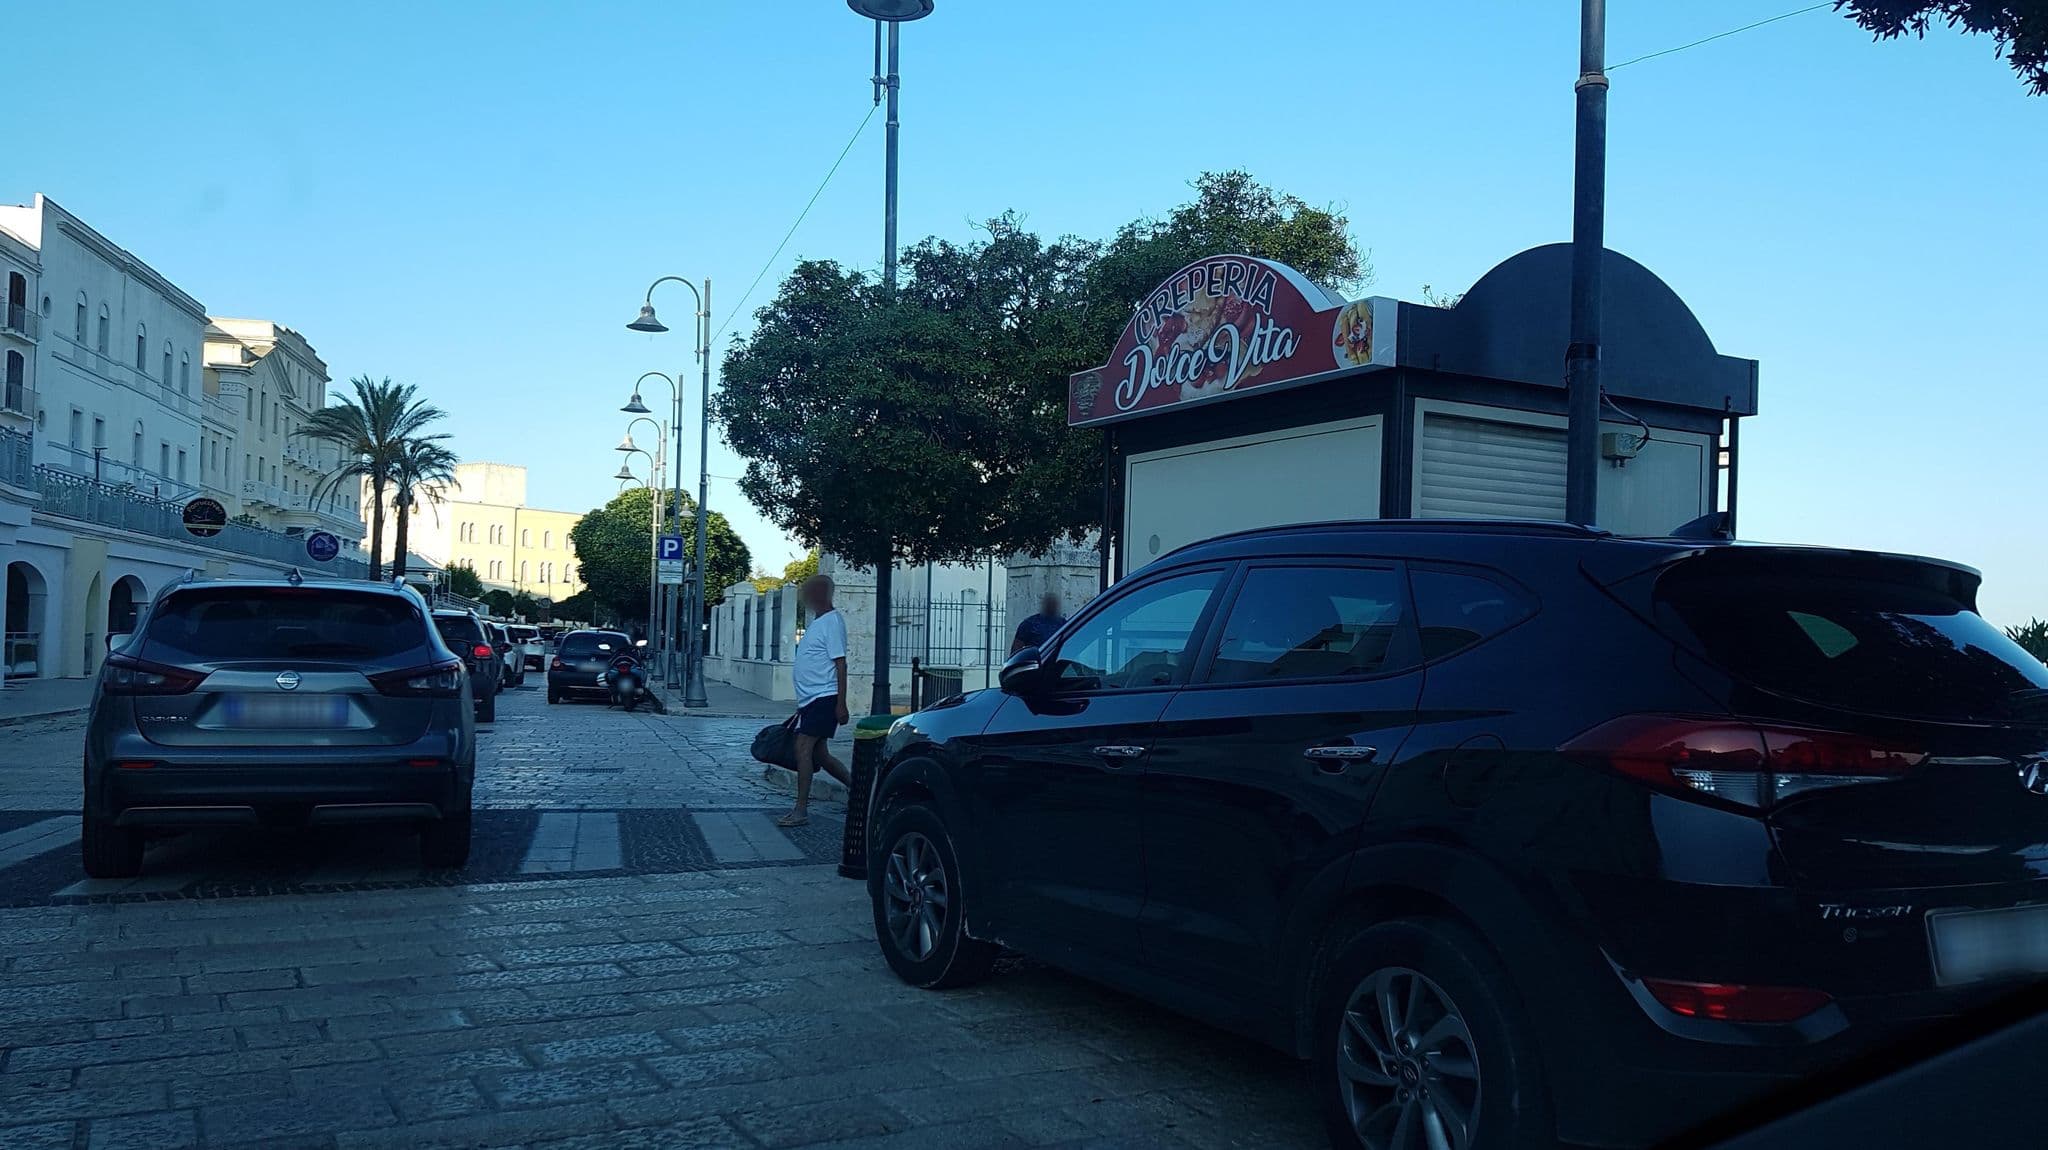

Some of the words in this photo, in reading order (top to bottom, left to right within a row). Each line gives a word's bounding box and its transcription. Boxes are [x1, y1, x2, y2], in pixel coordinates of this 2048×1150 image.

[1134, 261, 1276, 346] CREPERIA
[1115, 344, 1207, 411] Dolce
[1207, 313, 1301, 390] Vita
[664, 539, 679, 558] P
